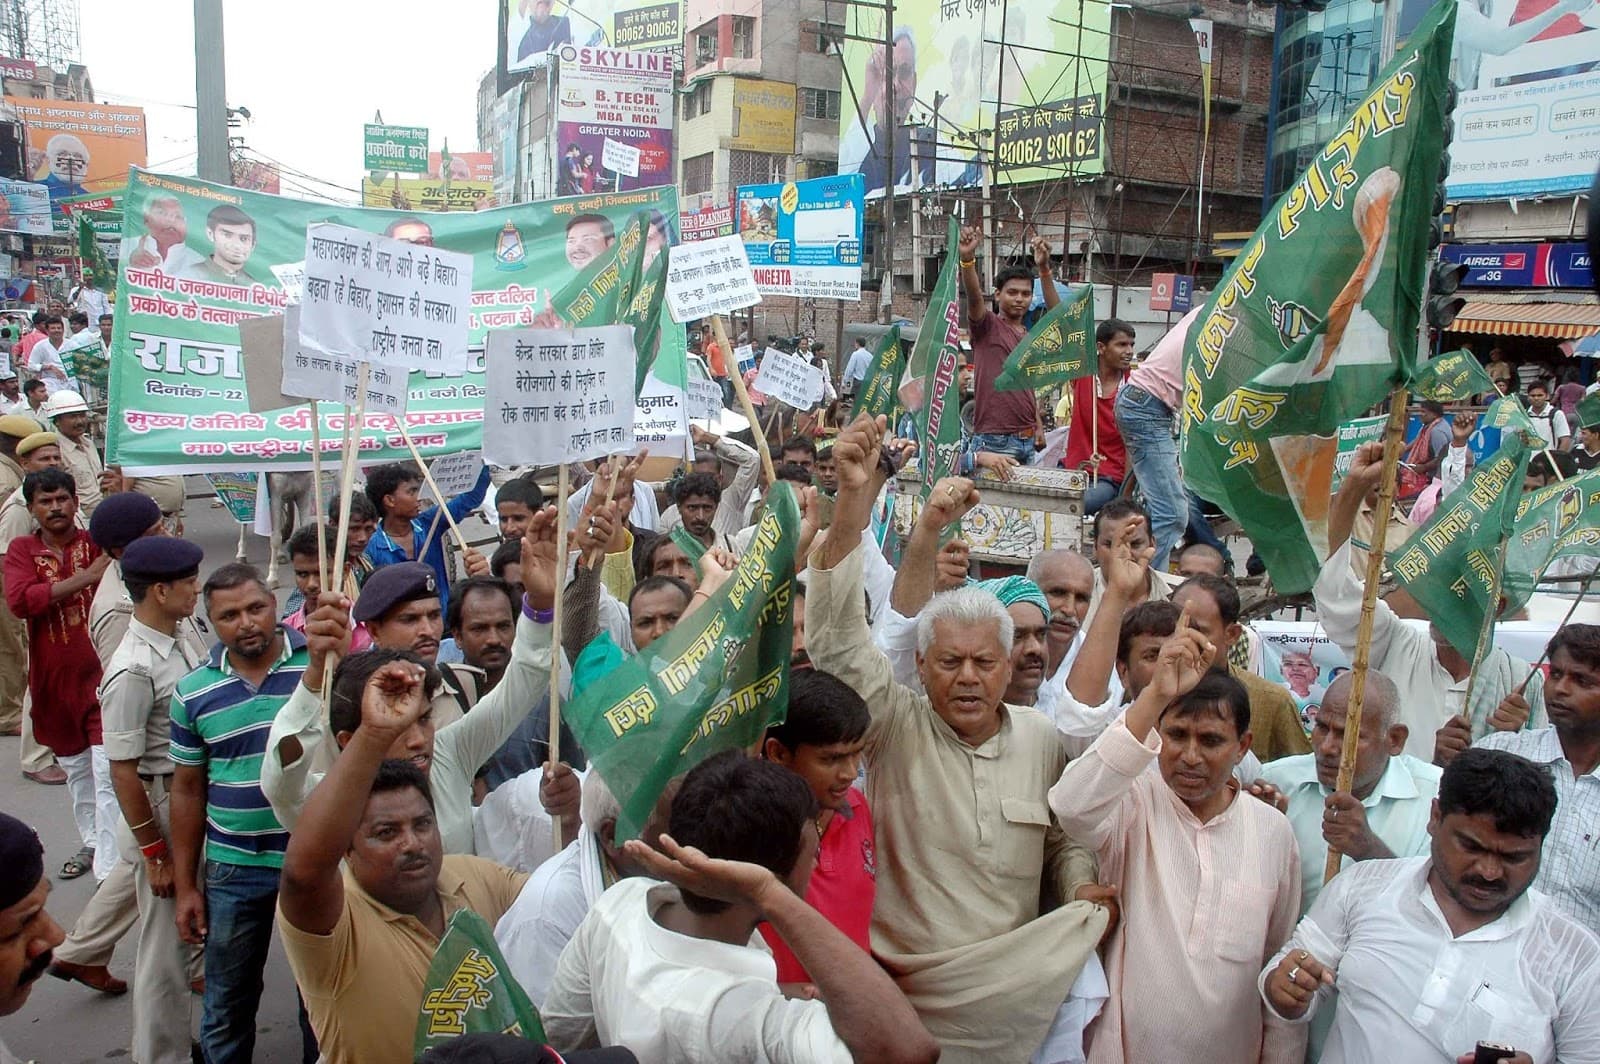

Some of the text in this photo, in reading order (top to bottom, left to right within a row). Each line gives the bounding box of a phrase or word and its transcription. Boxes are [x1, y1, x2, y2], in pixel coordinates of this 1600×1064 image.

[616, 21, 678, 43] 90062 90062
[580, 48, 673, 72] SKYLINE
[595, 89, 659, 106] B. TECH.
[597, 111, 658, 125] MBA MCA
[999, 113, 1019, 139] जुड़ने
[1022, 111, 1032, 129] के
[1034, 109, 1053, 128] लिए
[1079, 99, 1096, 119] करें
[579, 126, 651, 139] GREATER NOIDA
[366, 140, 427, 160] प्रकाशित करो
[999, 137, 1043, 167] 90062
[552, 204, 577, 216] लालू
[680, 209, 730, 229] EER PLANNER
[683, 231, 698, 240] SSC
[699, 229, 716, 239] MBA
[312, 237, 458, 286] महागठबंधन की शान, आगे बढ़े बिहार।
[1463, 257, 1502, 266] AIRCEL
[1574, 257, 1592, 266] AI
[753, 269, 791, 286] ANGEETA
[1487, 271, 1501, 281] 3G
[126, 269, 175, 291] जातीय
[180, 279, 249, 301] जनगणना
[252, 285, 289, 307] रिपोर्ट
[471, 292, 496, 305] जद
[497, 286, 535, 304] दलित
[307, 276, 330, 304] बढ़ता
[334, 275, 345, 304] रहे
[348, 278, 372, 315] बिहार,
[377, 290, 405, 320] सुशासन
[409, 292, 420, 316] की
[130, 295, 533, 326] प्रकोष्ठ के पटना से
[372, 326, 396, 357] राष्ट्रीय
[400, 333, 423, 358] जनता
[515, 339, 535, 361] केन्द्र
[539, 345, 568, 360] सरकार
[572, 344, 587, 361] द्वारा
[129, 331, 244, 379] राज
[295, 352, 308, 369] रोक
[312, 356, 331, 371] लगाना
[333, 358, 343, 373] बंद
[146, 381, 204, 397] दिनांक
[410, 391, 423, 400] 11
[430, 387, 456, 398] बजे
[560, 369, 572, 392] की
[366, 389, 384, 403] जनता
[635, 395, 678, 415] कुमार,
[126, 408, 484, 432] मुख्य अतिथि श्री लालू प्रसाद
[501, 402, 518, 424] रोक
[522, 406, 550, 423] लगाना
[553, 401, 568, 422] बंद
[571, 398, 587, 423] करो,
[229, 440, 299, 458] राष्ट्रीय
[389, 434, 446, 448] राजद
[571, 428, 592, 453] राष्ट्रीय
